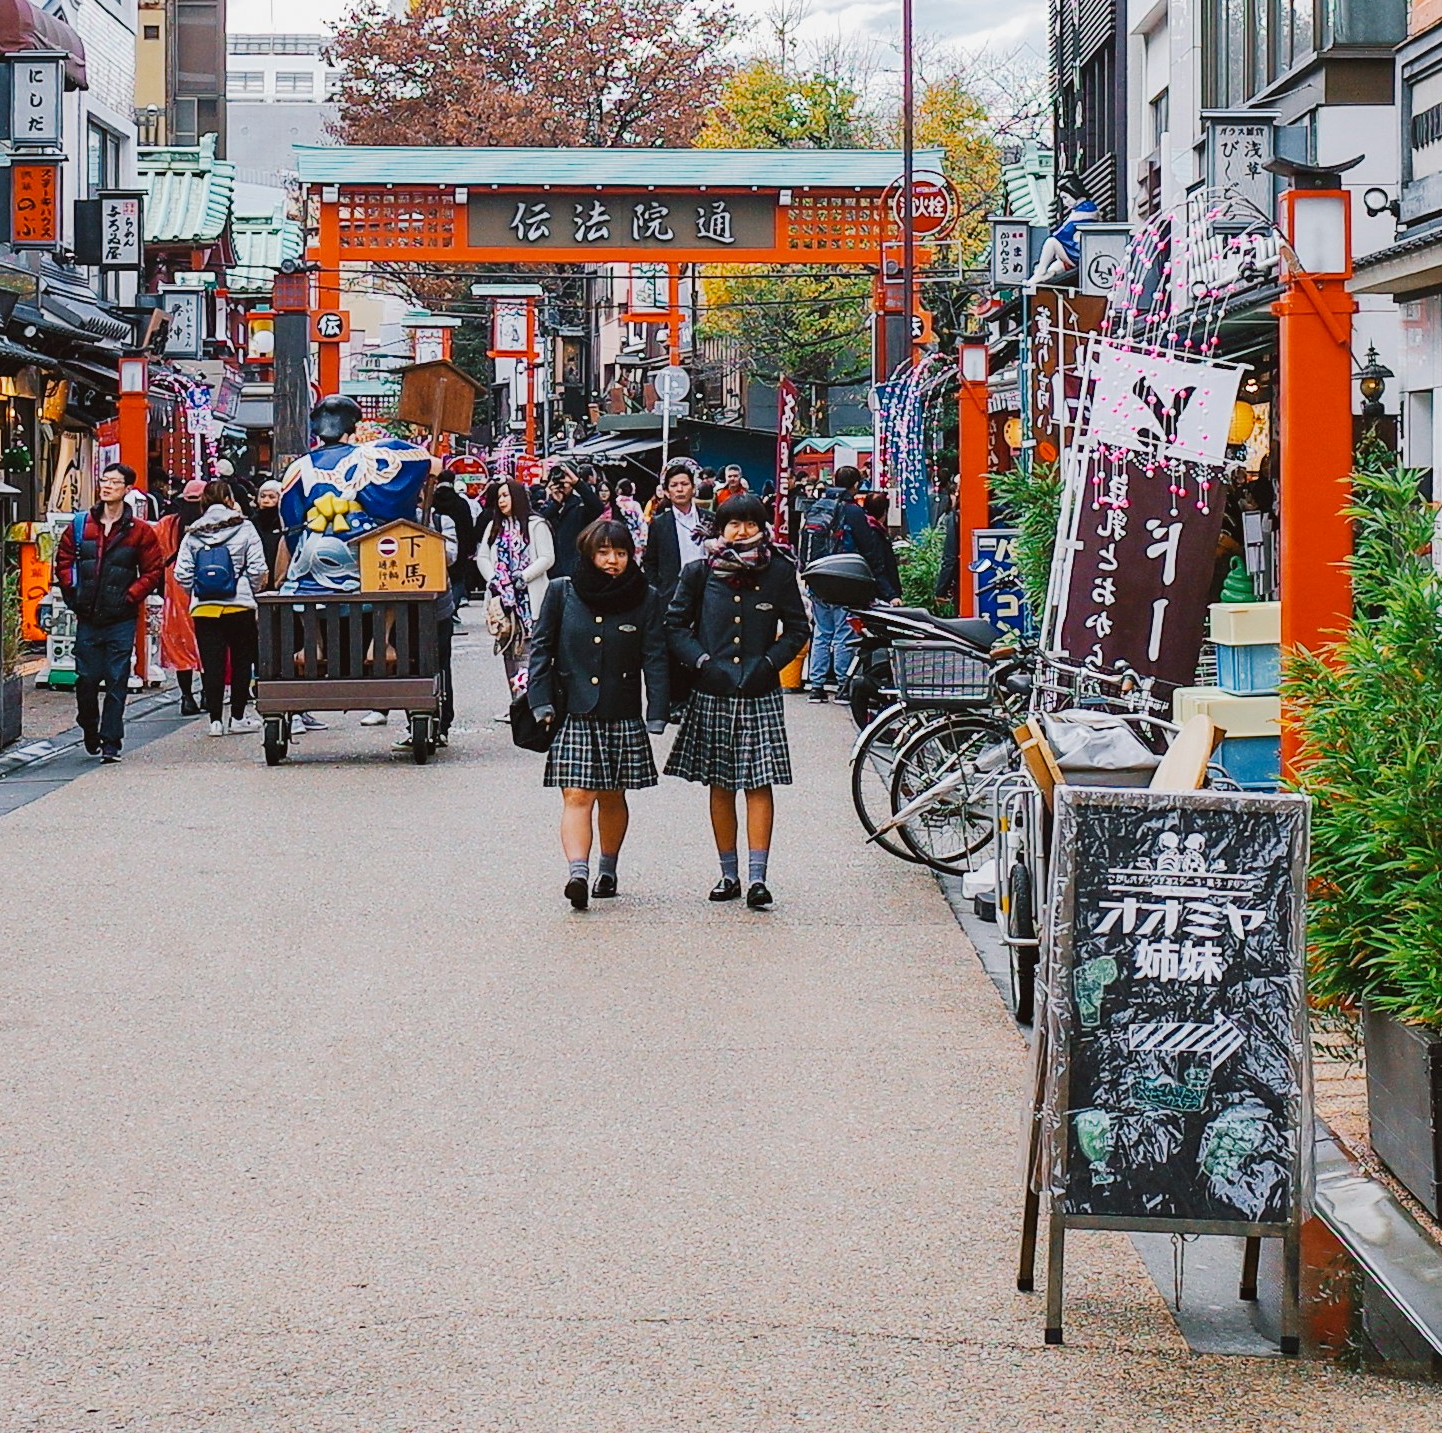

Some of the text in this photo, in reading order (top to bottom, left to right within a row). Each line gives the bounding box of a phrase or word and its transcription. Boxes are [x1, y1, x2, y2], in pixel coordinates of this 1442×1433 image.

[28, 68, 44, 132] にしだ
[1244, 140, 1262, 180] 浅草
[510, 200, 736, 244] 伝法院通
[318, 313, 341, 337] 伝
[400, 534, 427, 589] 下馬
[1093, 897, 1267, 940] オオミヤ
[1133, 938, 1224, 985] 姉妹
